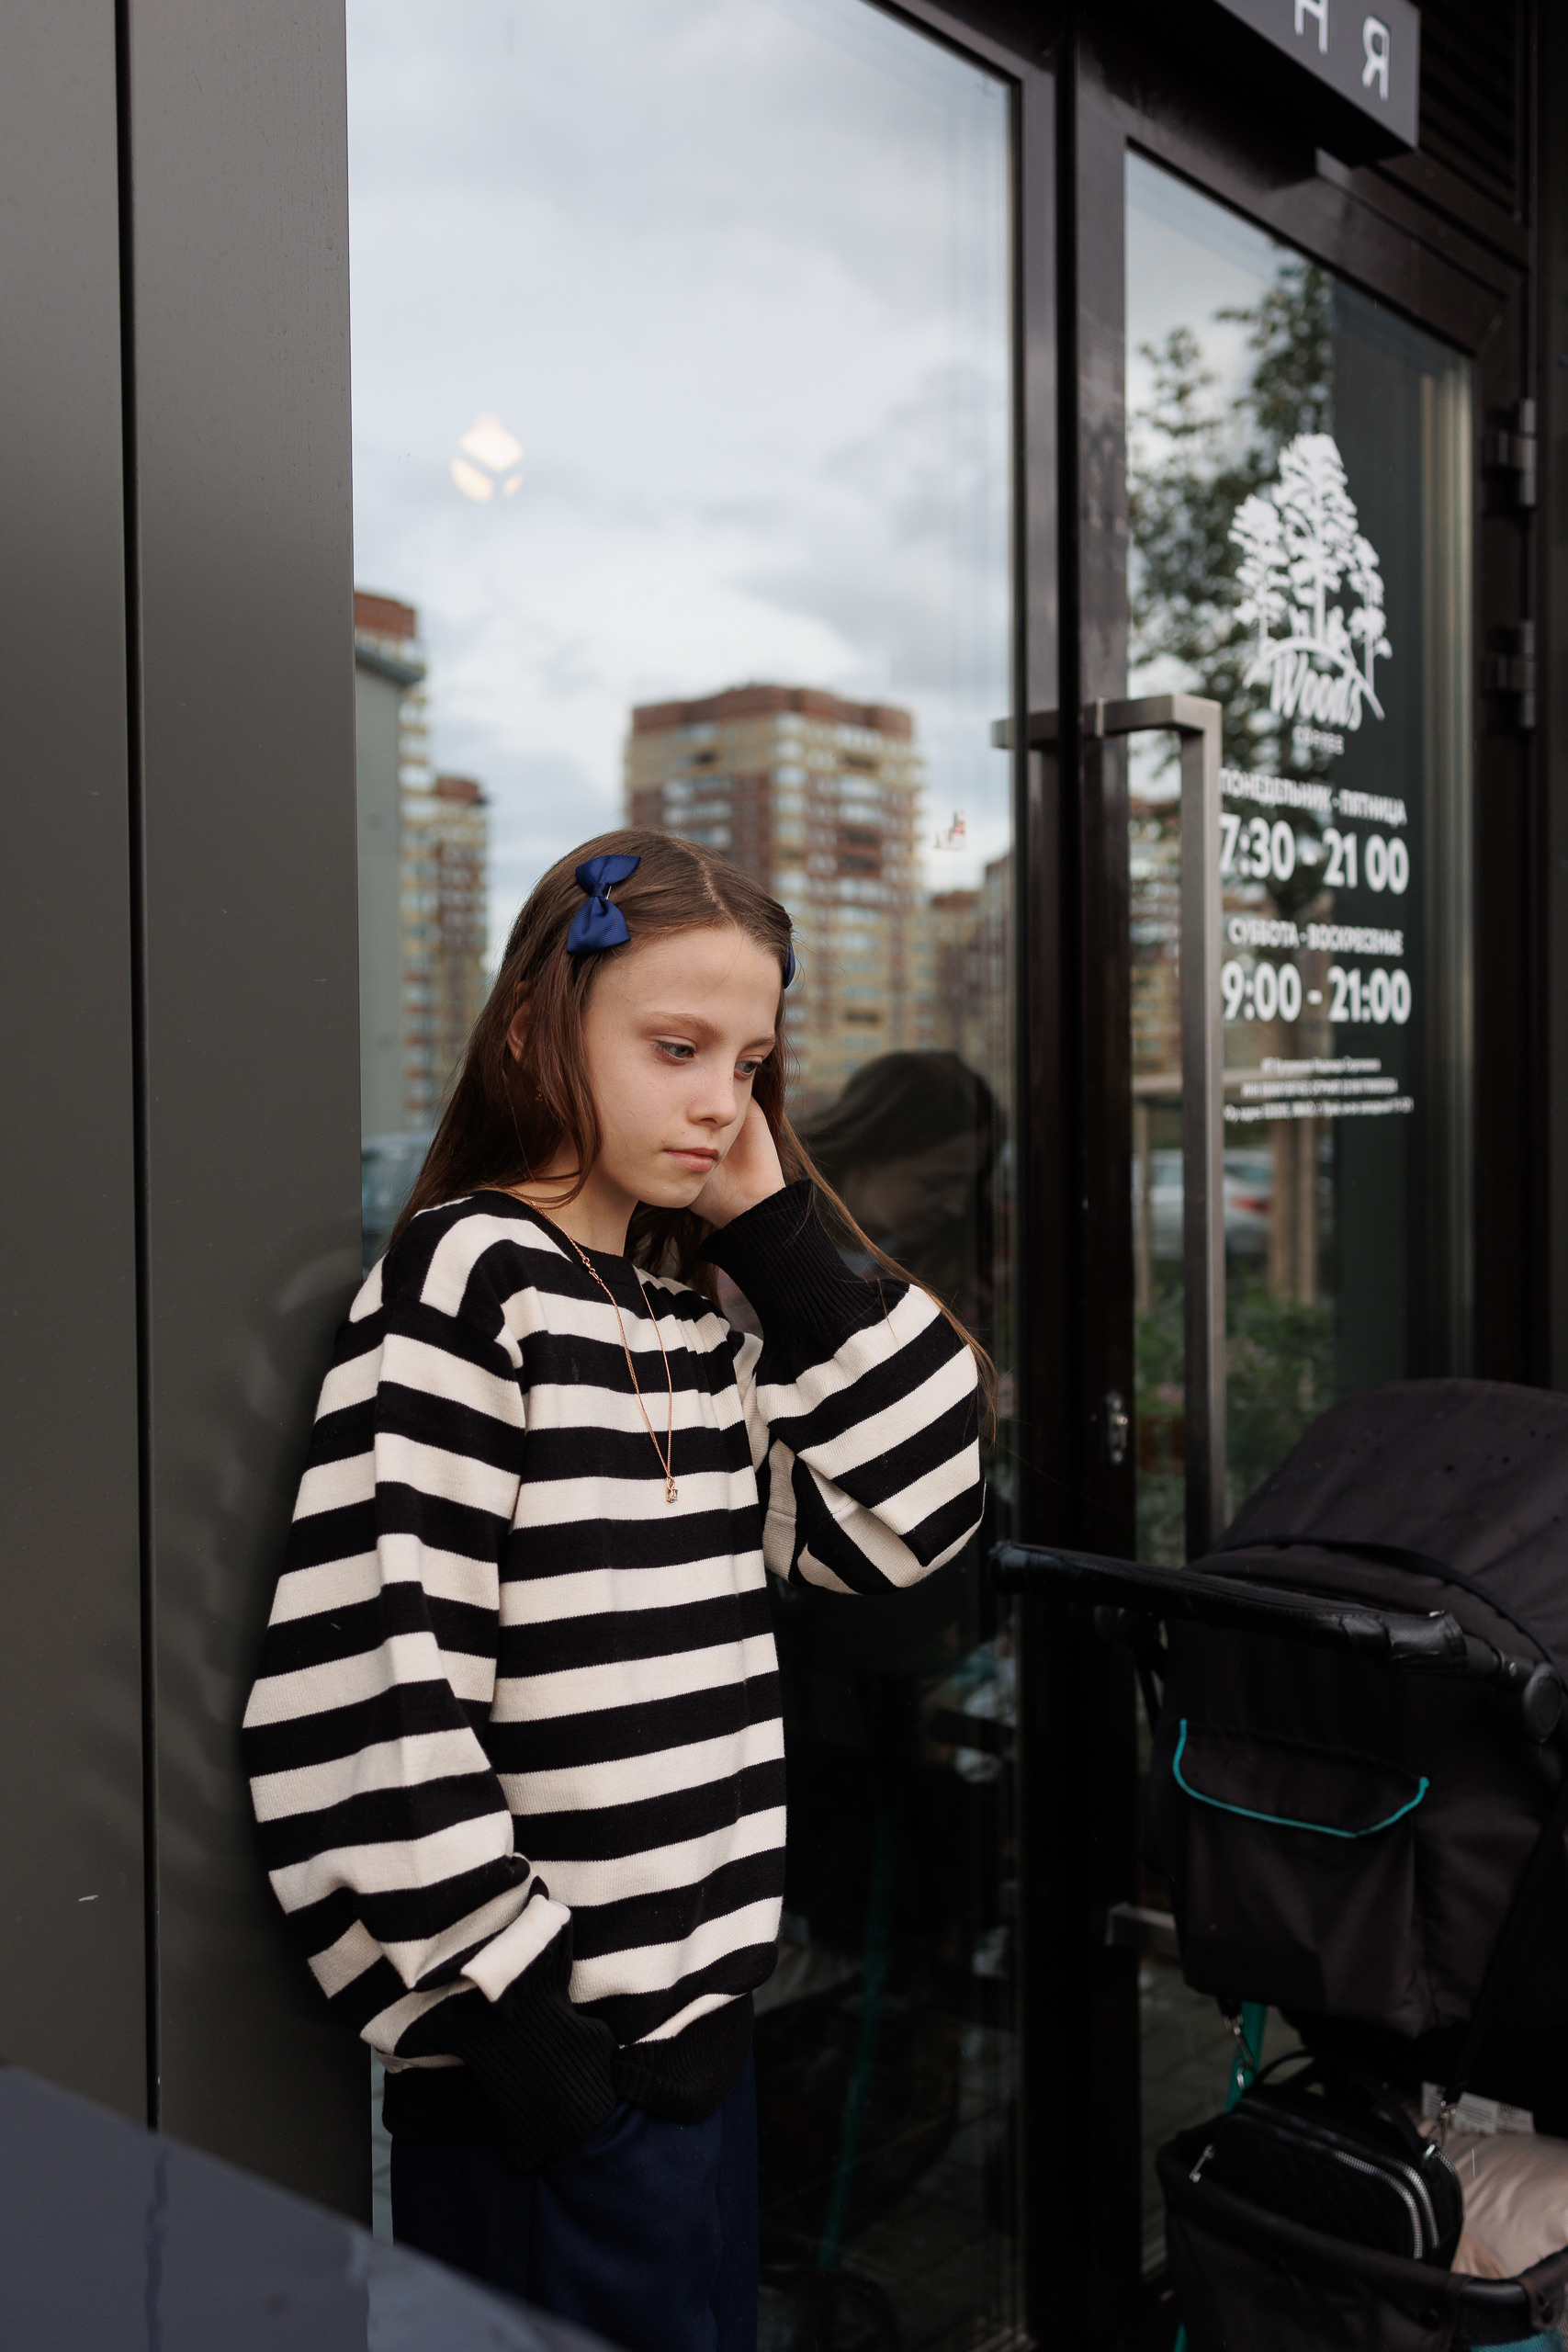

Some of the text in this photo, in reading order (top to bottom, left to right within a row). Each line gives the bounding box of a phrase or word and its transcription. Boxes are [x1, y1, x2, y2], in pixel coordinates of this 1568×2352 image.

[1339, 788, 1408, 828] ПЯТНИЦА
[1219, 812, 1296, 882] 7:30
[1228, 917, 1300, 949] СУББОТА
[1307, 922, 1404, 957] ВОСКРЕСЕНЬЕ
[1221, 960, 1303, 1023] 9:00
[1326, 965, 1412, 1024] 21:00
